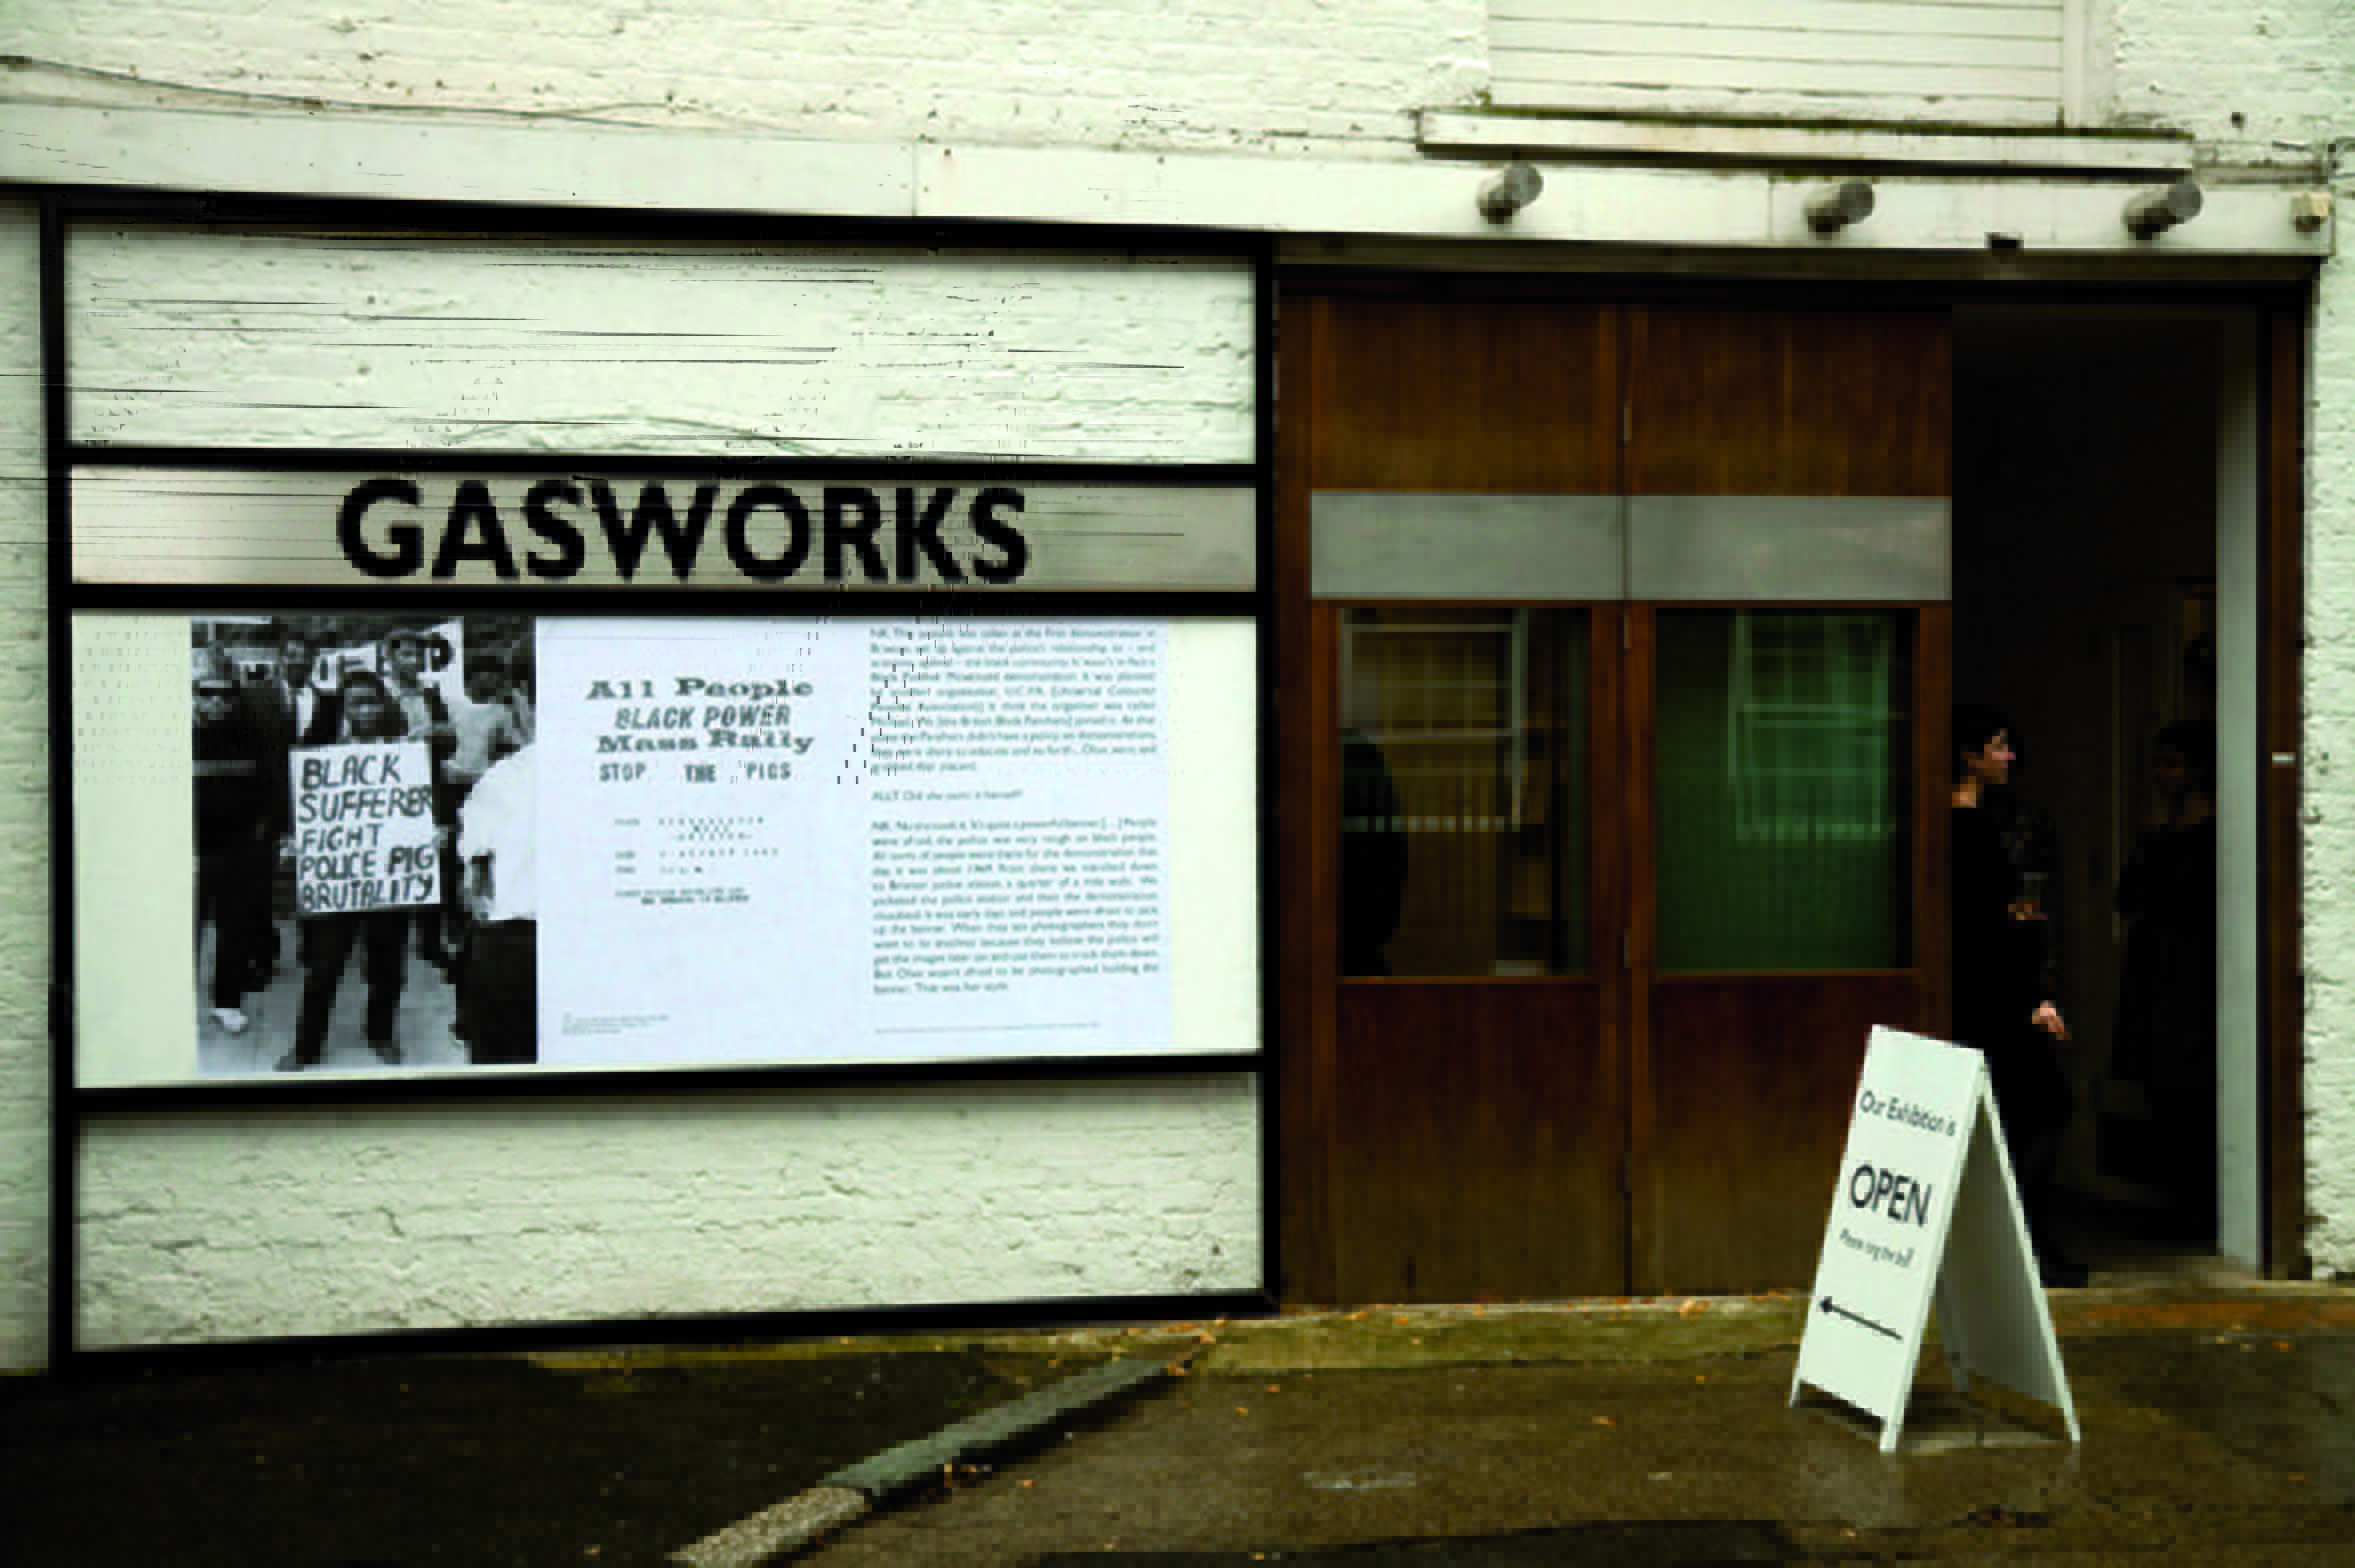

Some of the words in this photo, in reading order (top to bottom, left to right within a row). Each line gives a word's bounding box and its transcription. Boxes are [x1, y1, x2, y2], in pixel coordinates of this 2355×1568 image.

[337, 478, 1030, 584] GASWORKS
[586, 680, 655, 700] All
[674, 677, 814, 701] People
[615, 706, 695, 730] BLACK
[703, 704, 791, 728] POWER
[596, 735, 699, 753] Mass
[707, 729, 815, 755] Rally
[302, 754, 401, 790] BLACK
[600, 762, 646, 782] STOP
[684, 764, 716, 783] THE
[302, 823, 384, 853] FIGHT
[300, 850, 376, 881] POLICE
[388, 844, 434, 875] PIG
[302, 874, 433, 912] BRUTALITY
[1859, 1090, 1887, 1115] Our
[1850, 1163, 1932, 1227] OPEN
